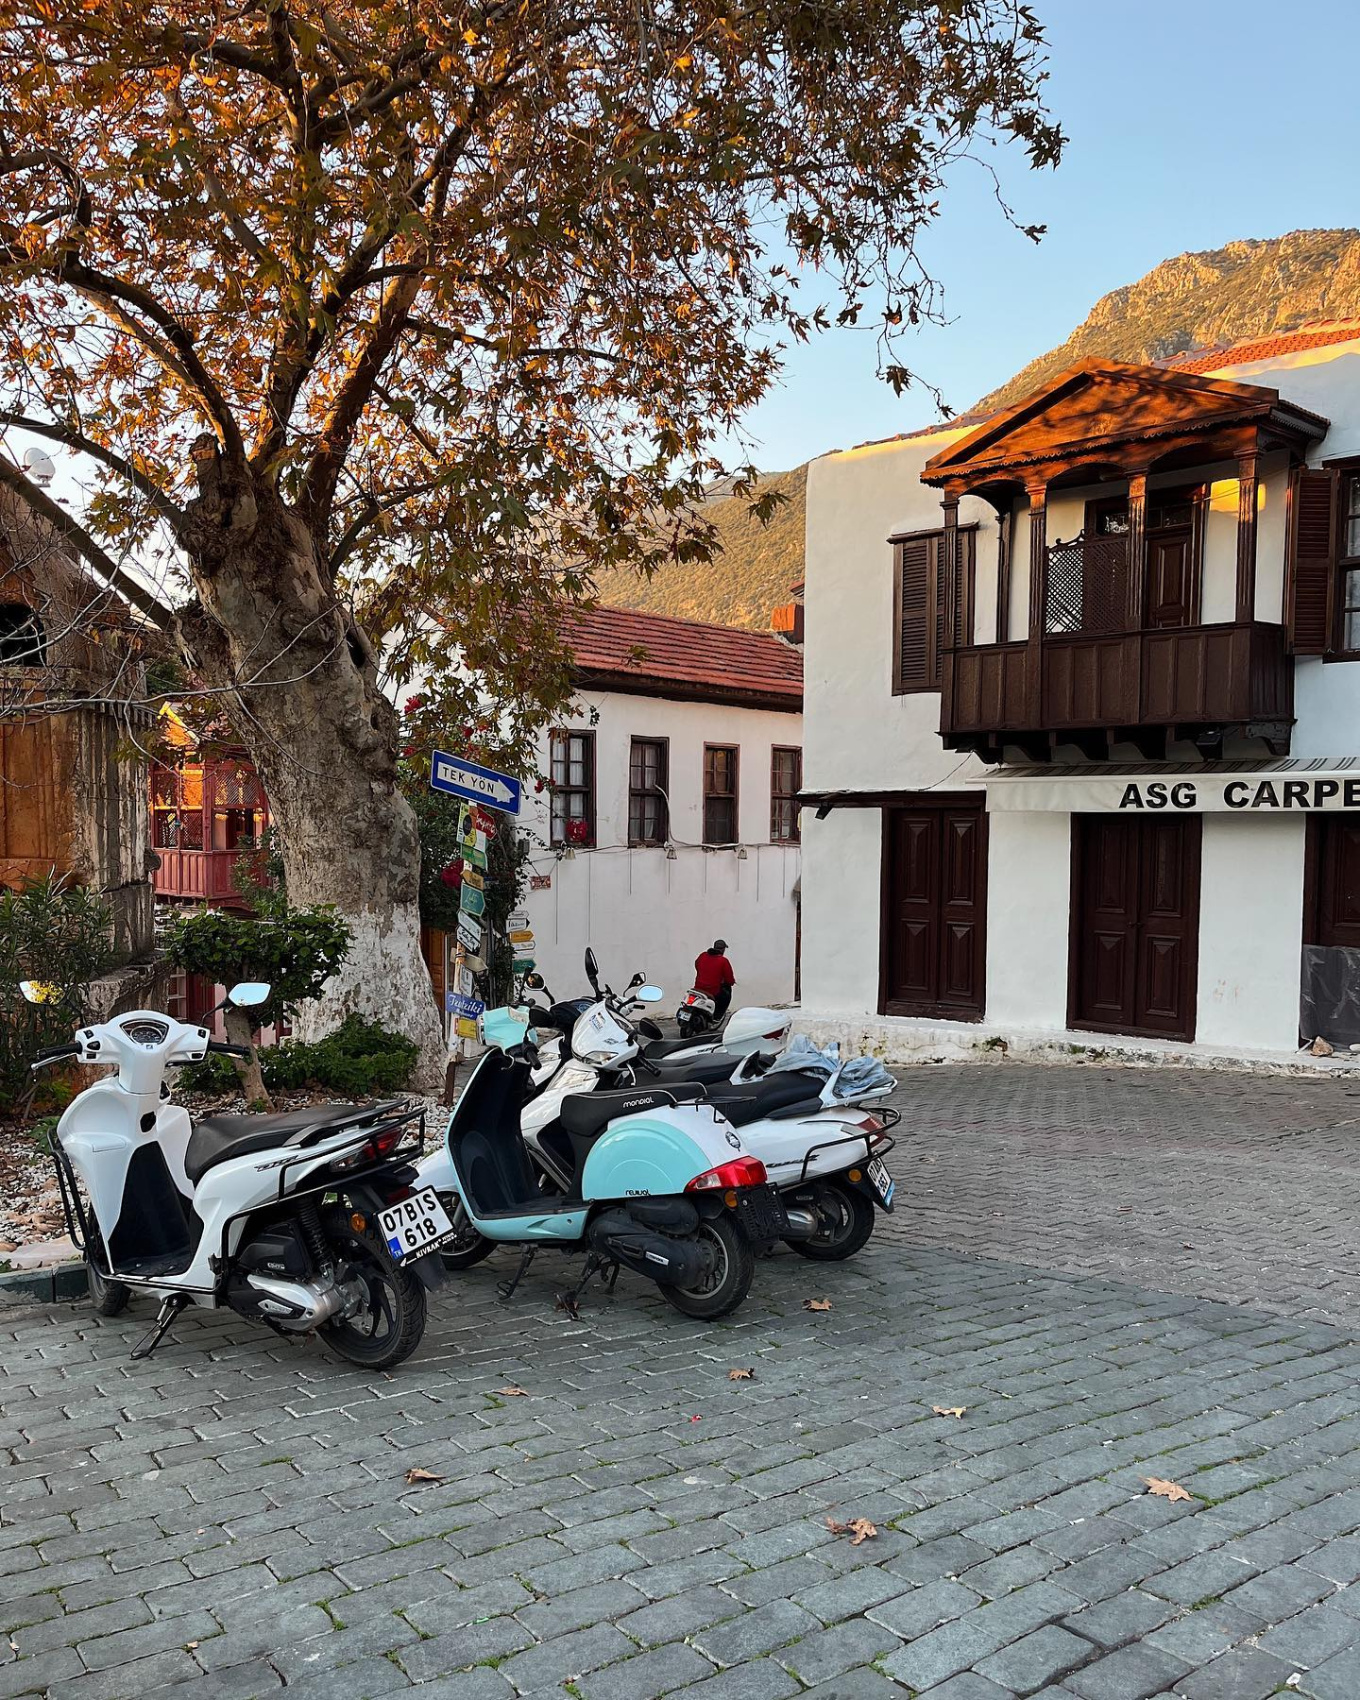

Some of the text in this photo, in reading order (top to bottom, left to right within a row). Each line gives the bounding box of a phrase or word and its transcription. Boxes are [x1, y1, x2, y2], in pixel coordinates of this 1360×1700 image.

[443, 767, 494, 793] TEK YÖN
[1119, 779, 1360, 808] ASG CARPE
[404, 1218, 437, 1246] 618
